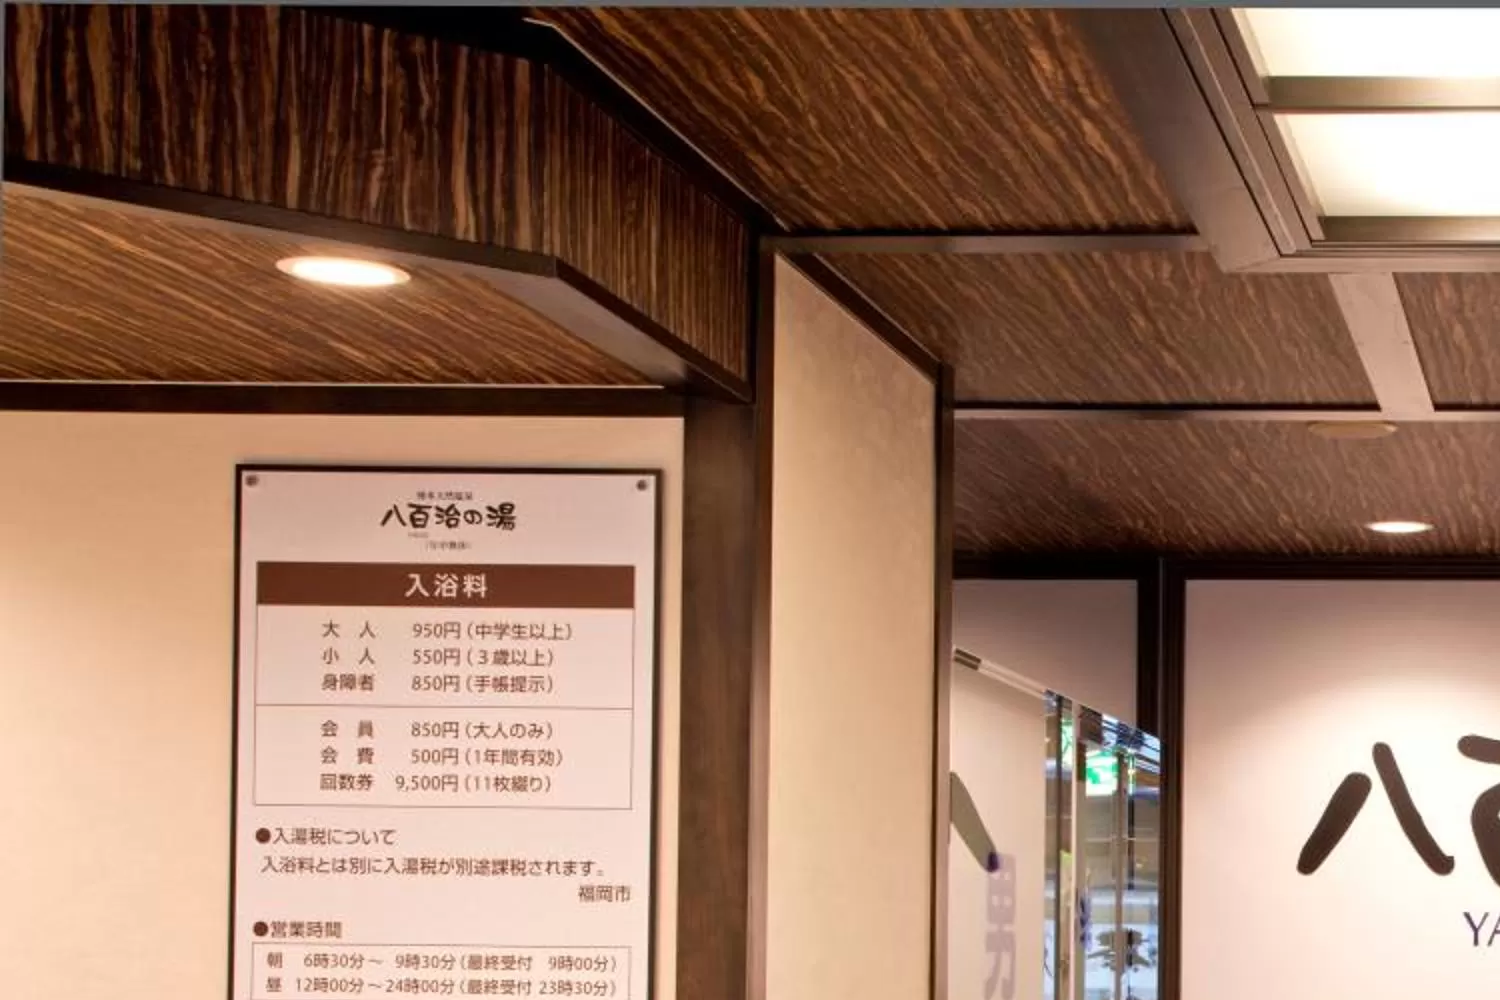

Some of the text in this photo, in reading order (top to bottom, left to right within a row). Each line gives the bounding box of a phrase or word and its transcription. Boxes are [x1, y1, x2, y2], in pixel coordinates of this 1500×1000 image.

[380, 502, 517, 531] 八百治の湯
[404, 572, 489, 599] 入浴料
[321, 672, 376, 692] 身障者
[319, 773, 376, 792] 回数券
[577, 883, 632, 904] 福岡市
